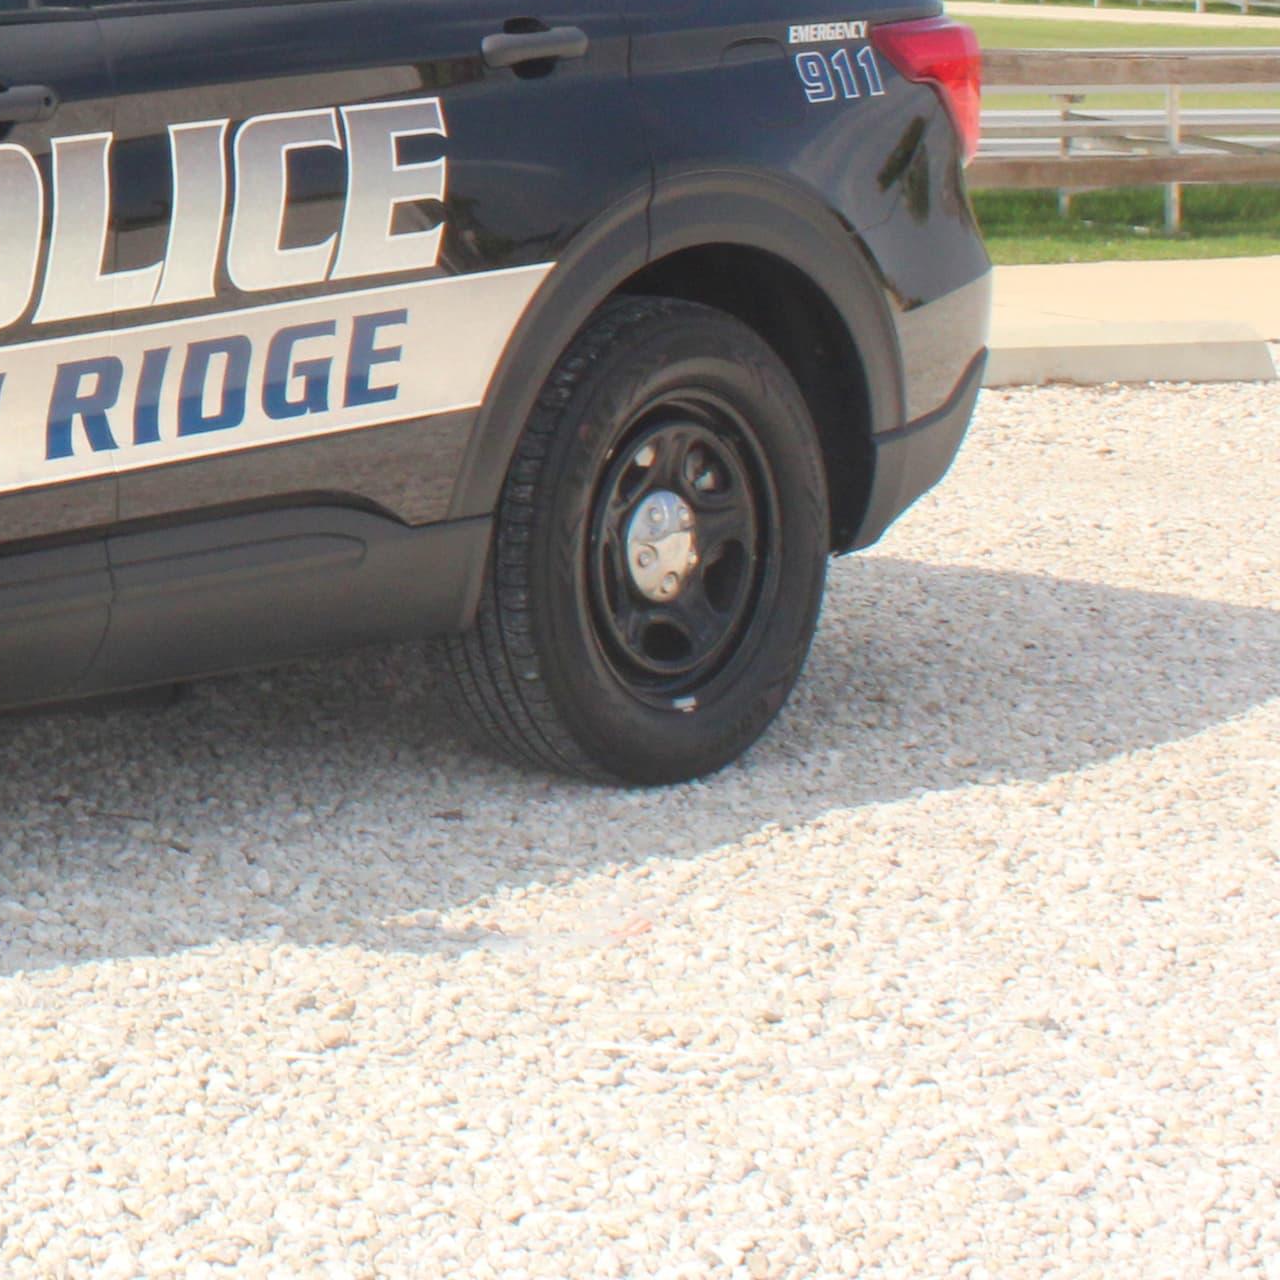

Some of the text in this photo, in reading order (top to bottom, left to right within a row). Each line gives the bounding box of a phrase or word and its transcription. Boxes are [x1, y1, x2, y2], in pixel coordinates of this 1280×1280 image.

[788, 21, 868, 43] EMERGENCY
[795, 46, 885, 104] 911
[46, 307, 408, 462] RIDGE
